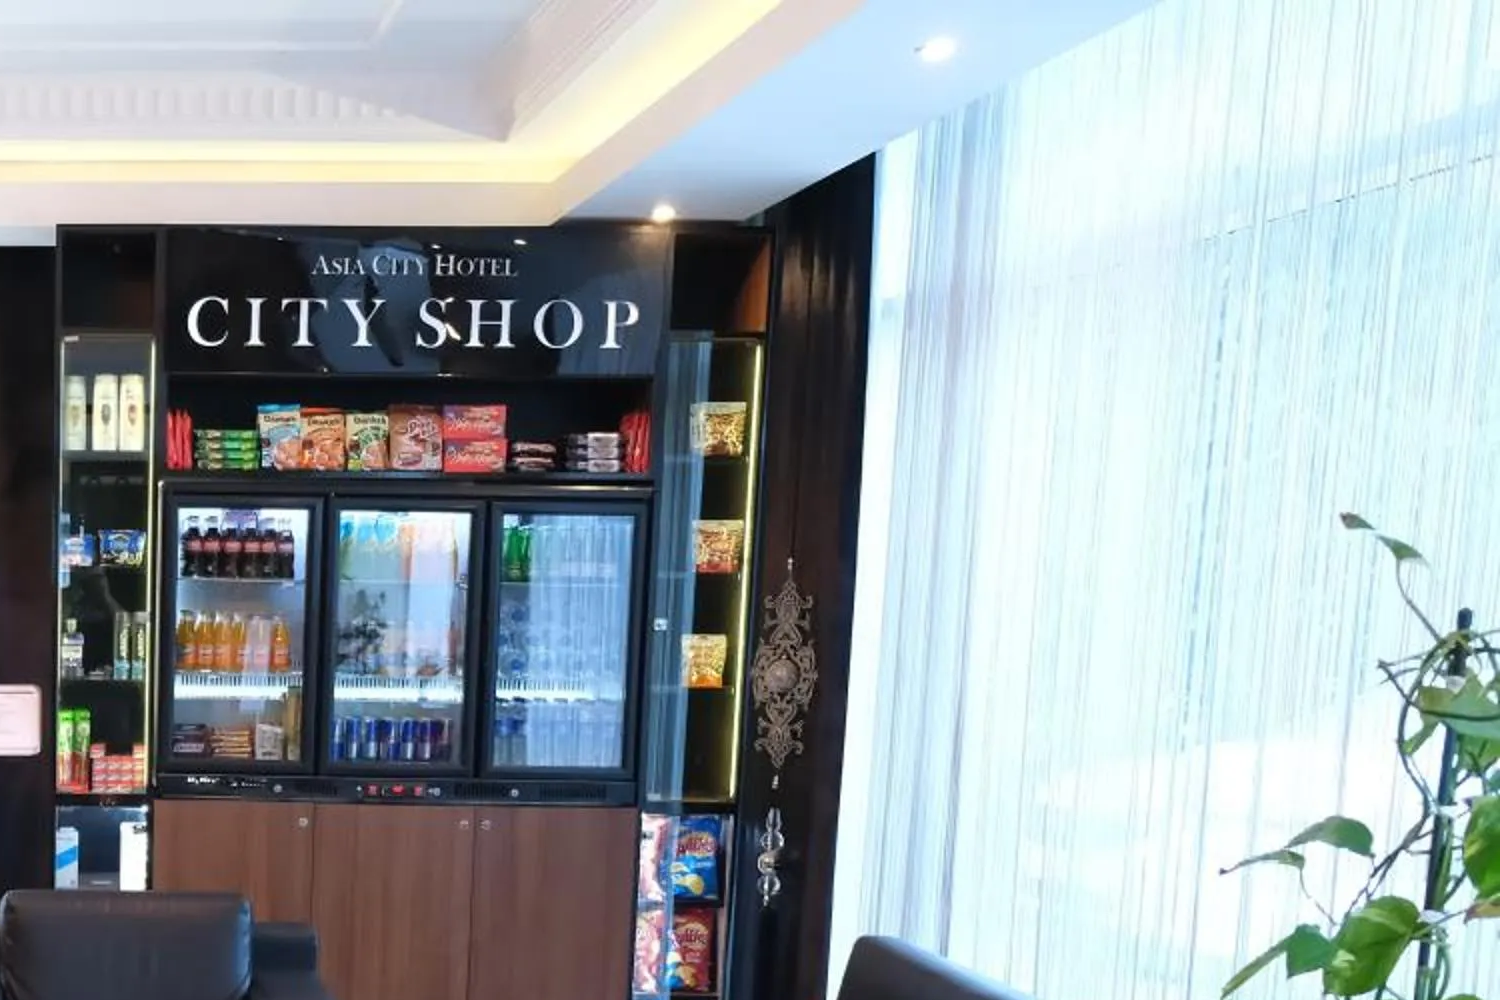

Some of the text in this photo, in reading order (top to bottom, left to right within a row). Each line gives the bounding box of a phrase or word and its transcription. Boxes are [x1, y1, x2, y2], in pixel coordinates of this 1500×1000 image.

[311, 253, 518, 277] ASIA CITY HOTEL
[187, 296, 640, 349] CITY SHOP
